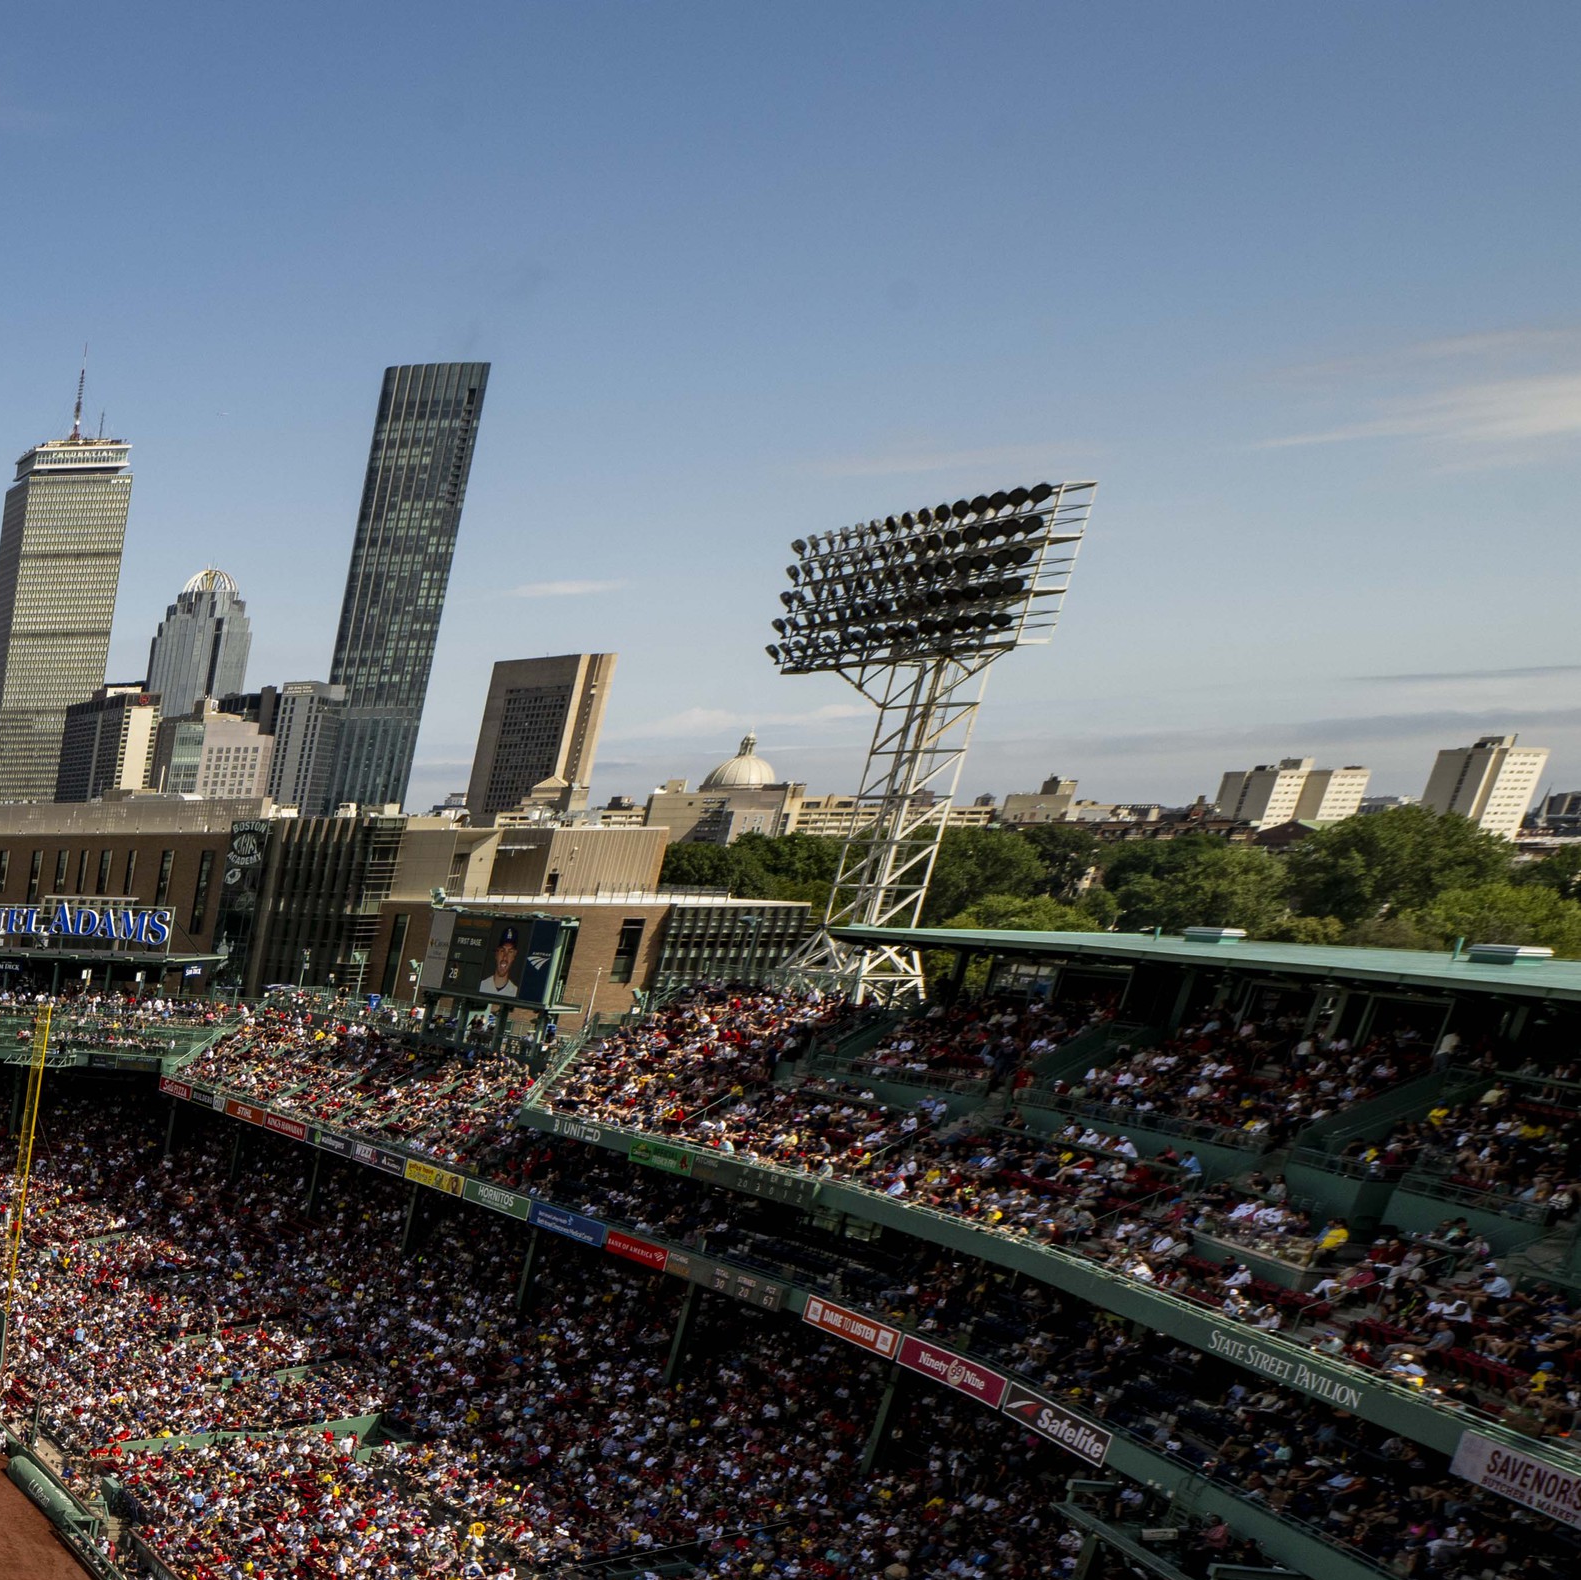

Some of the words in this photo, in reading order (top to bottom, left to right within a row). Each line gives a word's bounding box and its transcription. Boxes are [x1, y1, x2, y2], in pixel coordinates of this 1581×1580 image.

[232, 822, 267, 833] BOSTON
[227, 851, 262, 865] ACADEMY
[48, 901, 170, 946] ADAMS
[478, 1186, 514, 1207] HORNITOS
[823, 1308, 841, 1328] DARE
[850, 1321, 877, 1342] LISTEN
[919, 1351, 948, 1376] Ninety
[963, 1371, 985, 1391] Nine
[1207, 1329, 1245, 1362] STATE
[1245, 1344, 1291, 1380] STREET
[1290, 1362, 1363, 1409] PAVILION
[1036, 1408, 1105, 1460] Safelite
